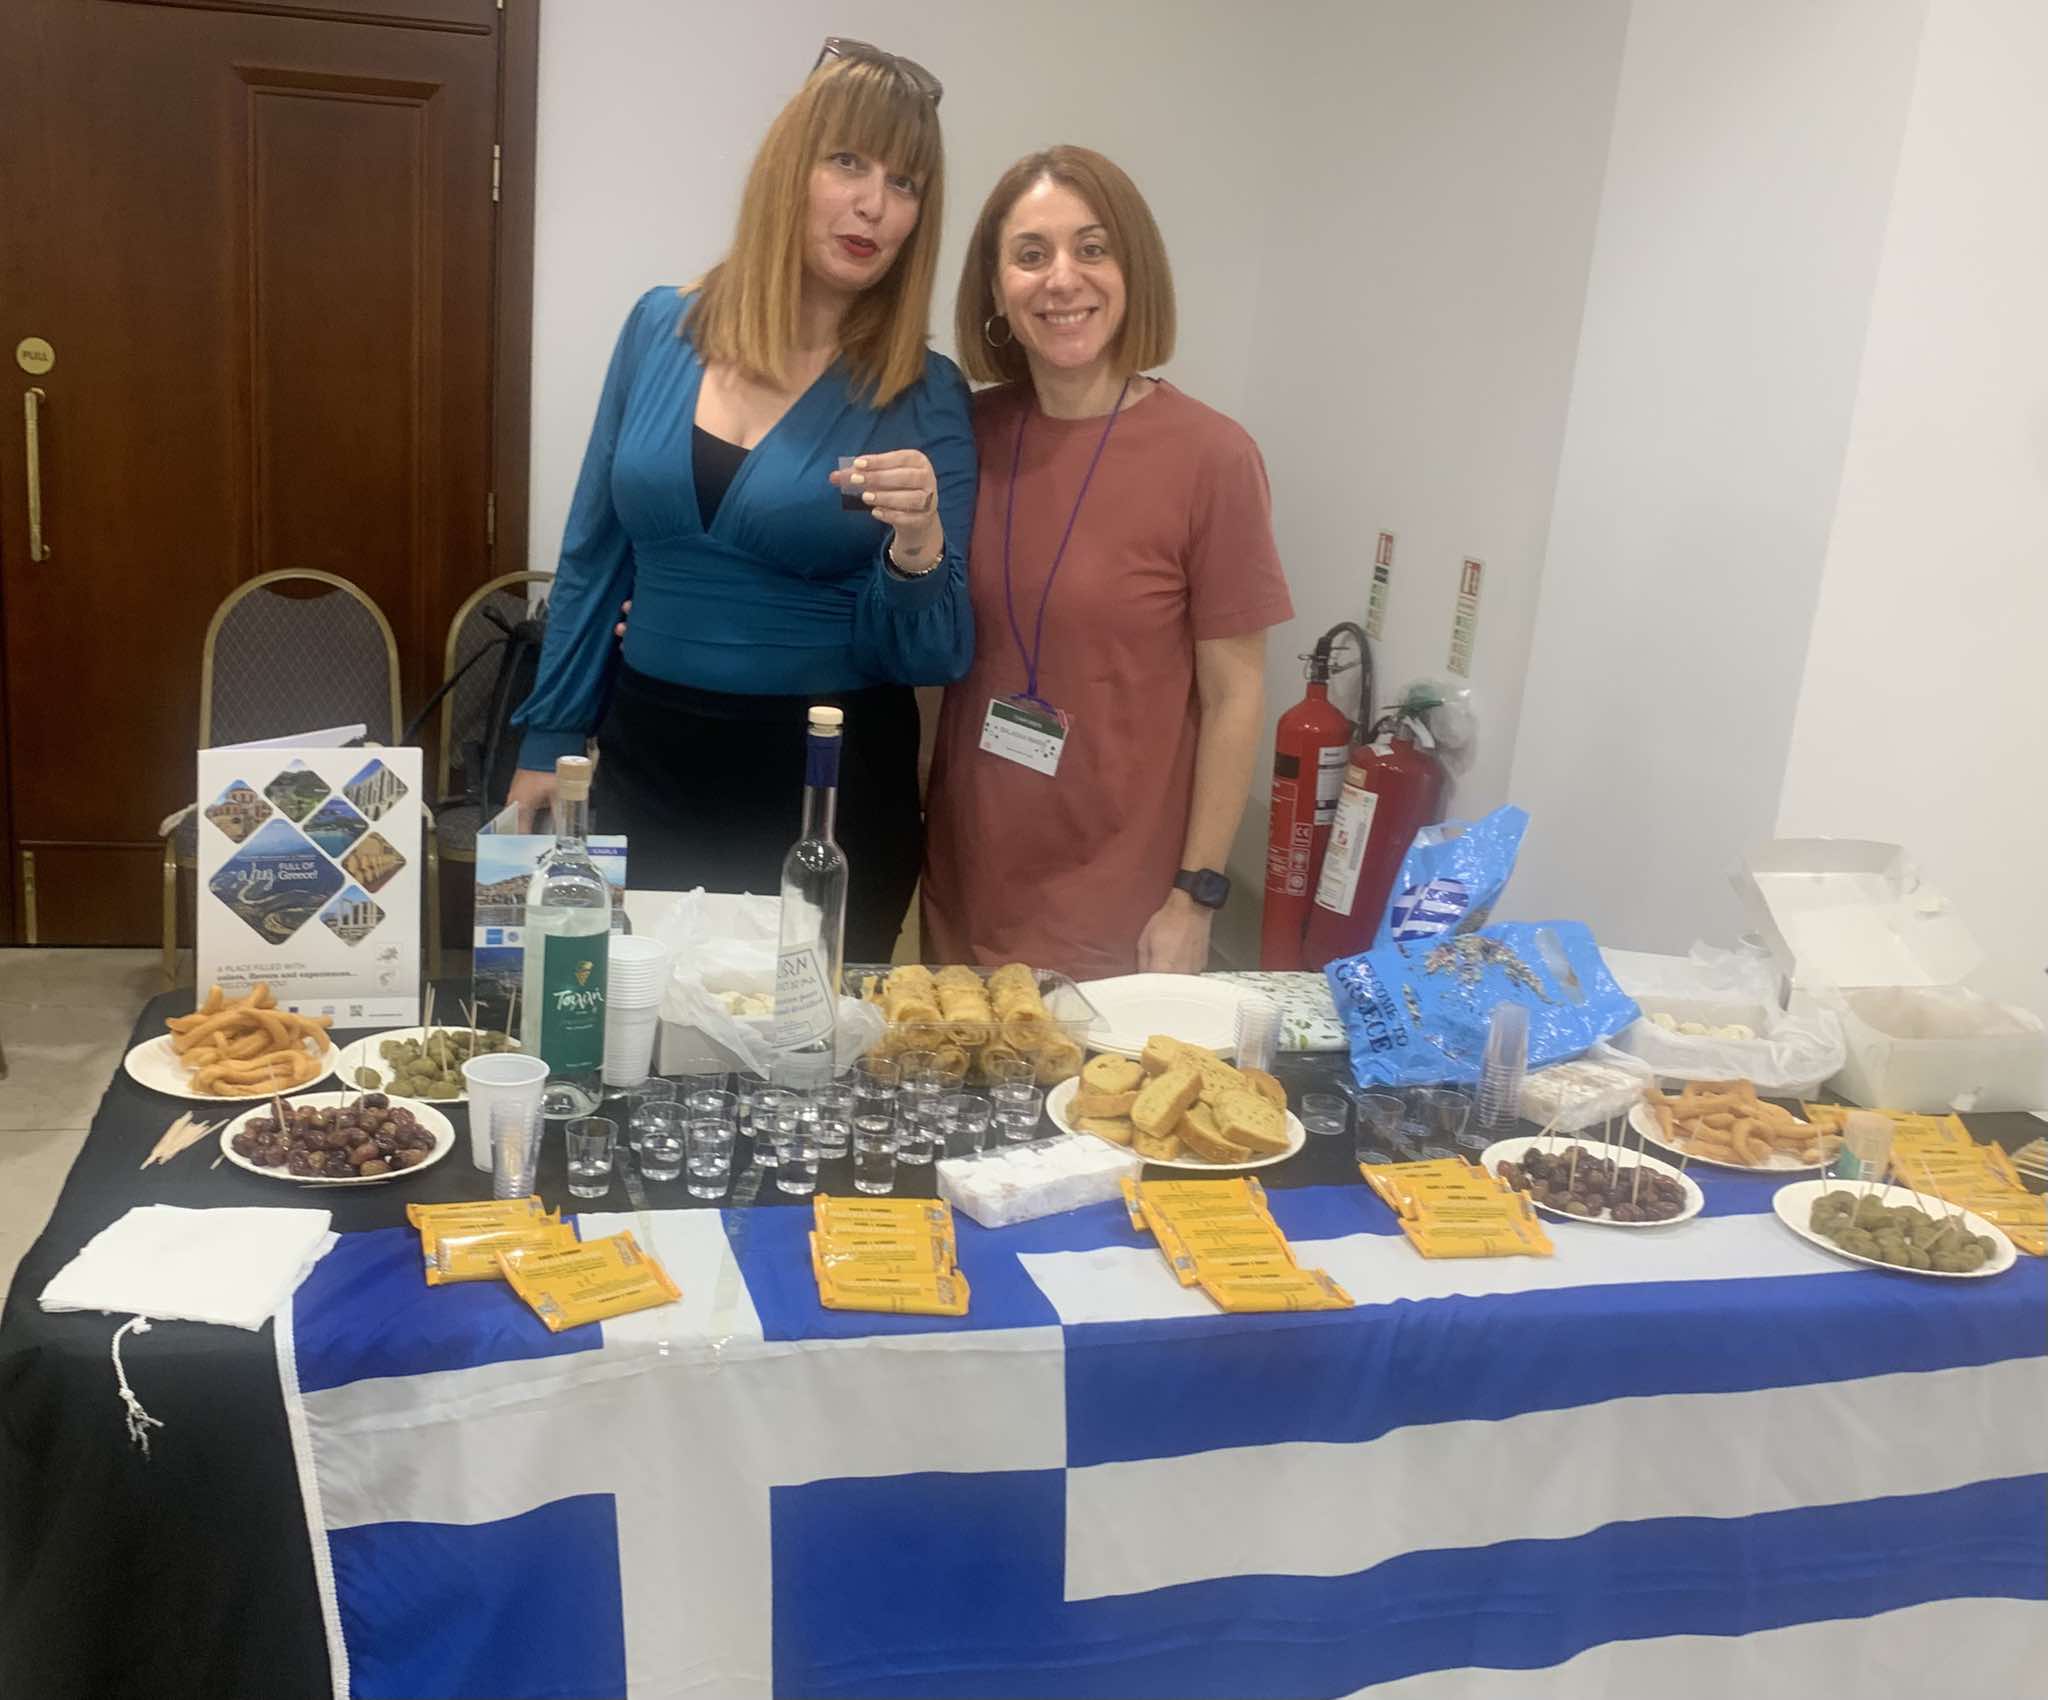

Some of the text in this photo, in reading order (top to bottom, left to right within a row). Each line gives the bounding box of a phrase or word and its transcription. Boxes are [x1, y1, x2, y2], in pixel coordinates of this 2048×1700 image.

[22, 350, 49, 361] PULL
[278, 861, 316, 871] FULL OF
[1391, 1025, 1409, 1047] TO
